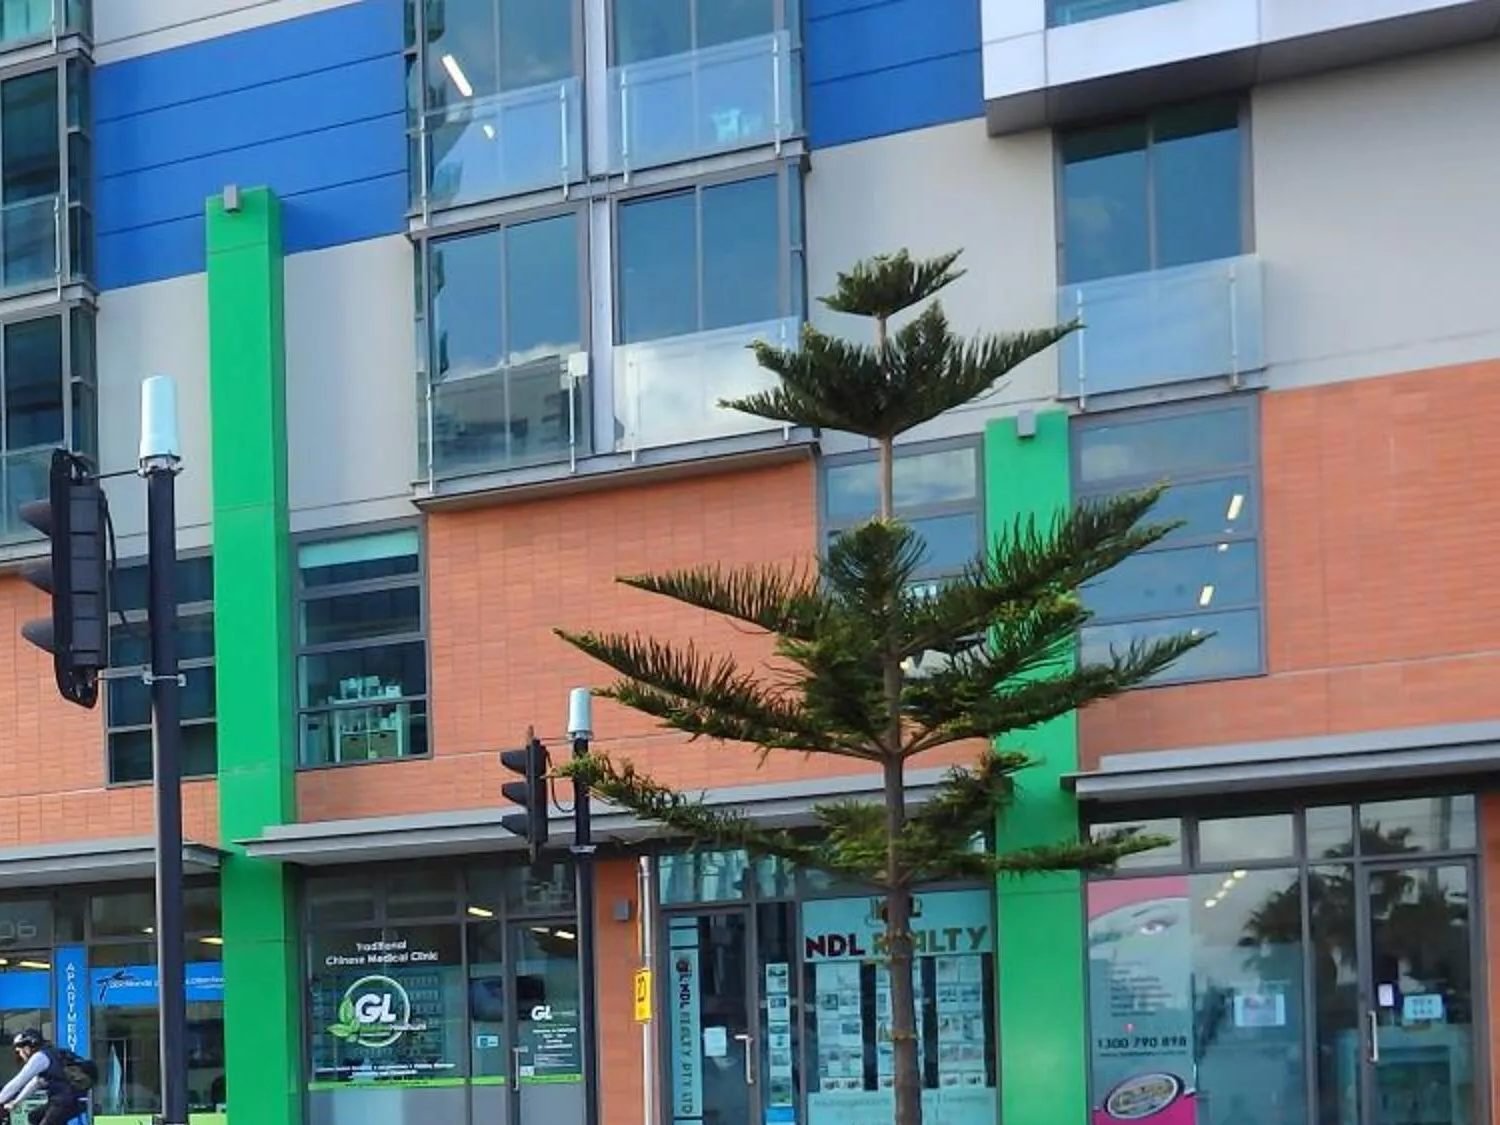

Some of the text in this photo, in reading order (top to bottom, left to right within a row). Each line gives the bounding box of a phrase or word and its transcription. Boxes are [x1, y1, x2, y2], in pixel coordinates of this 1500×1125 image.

[805, 932, 866, 959] NDL
[325, 951, 439, 966] Chinese Medical Clinic
[355, 993, 397, 1023] GL
[531, 1005, 553, 1021] GL
